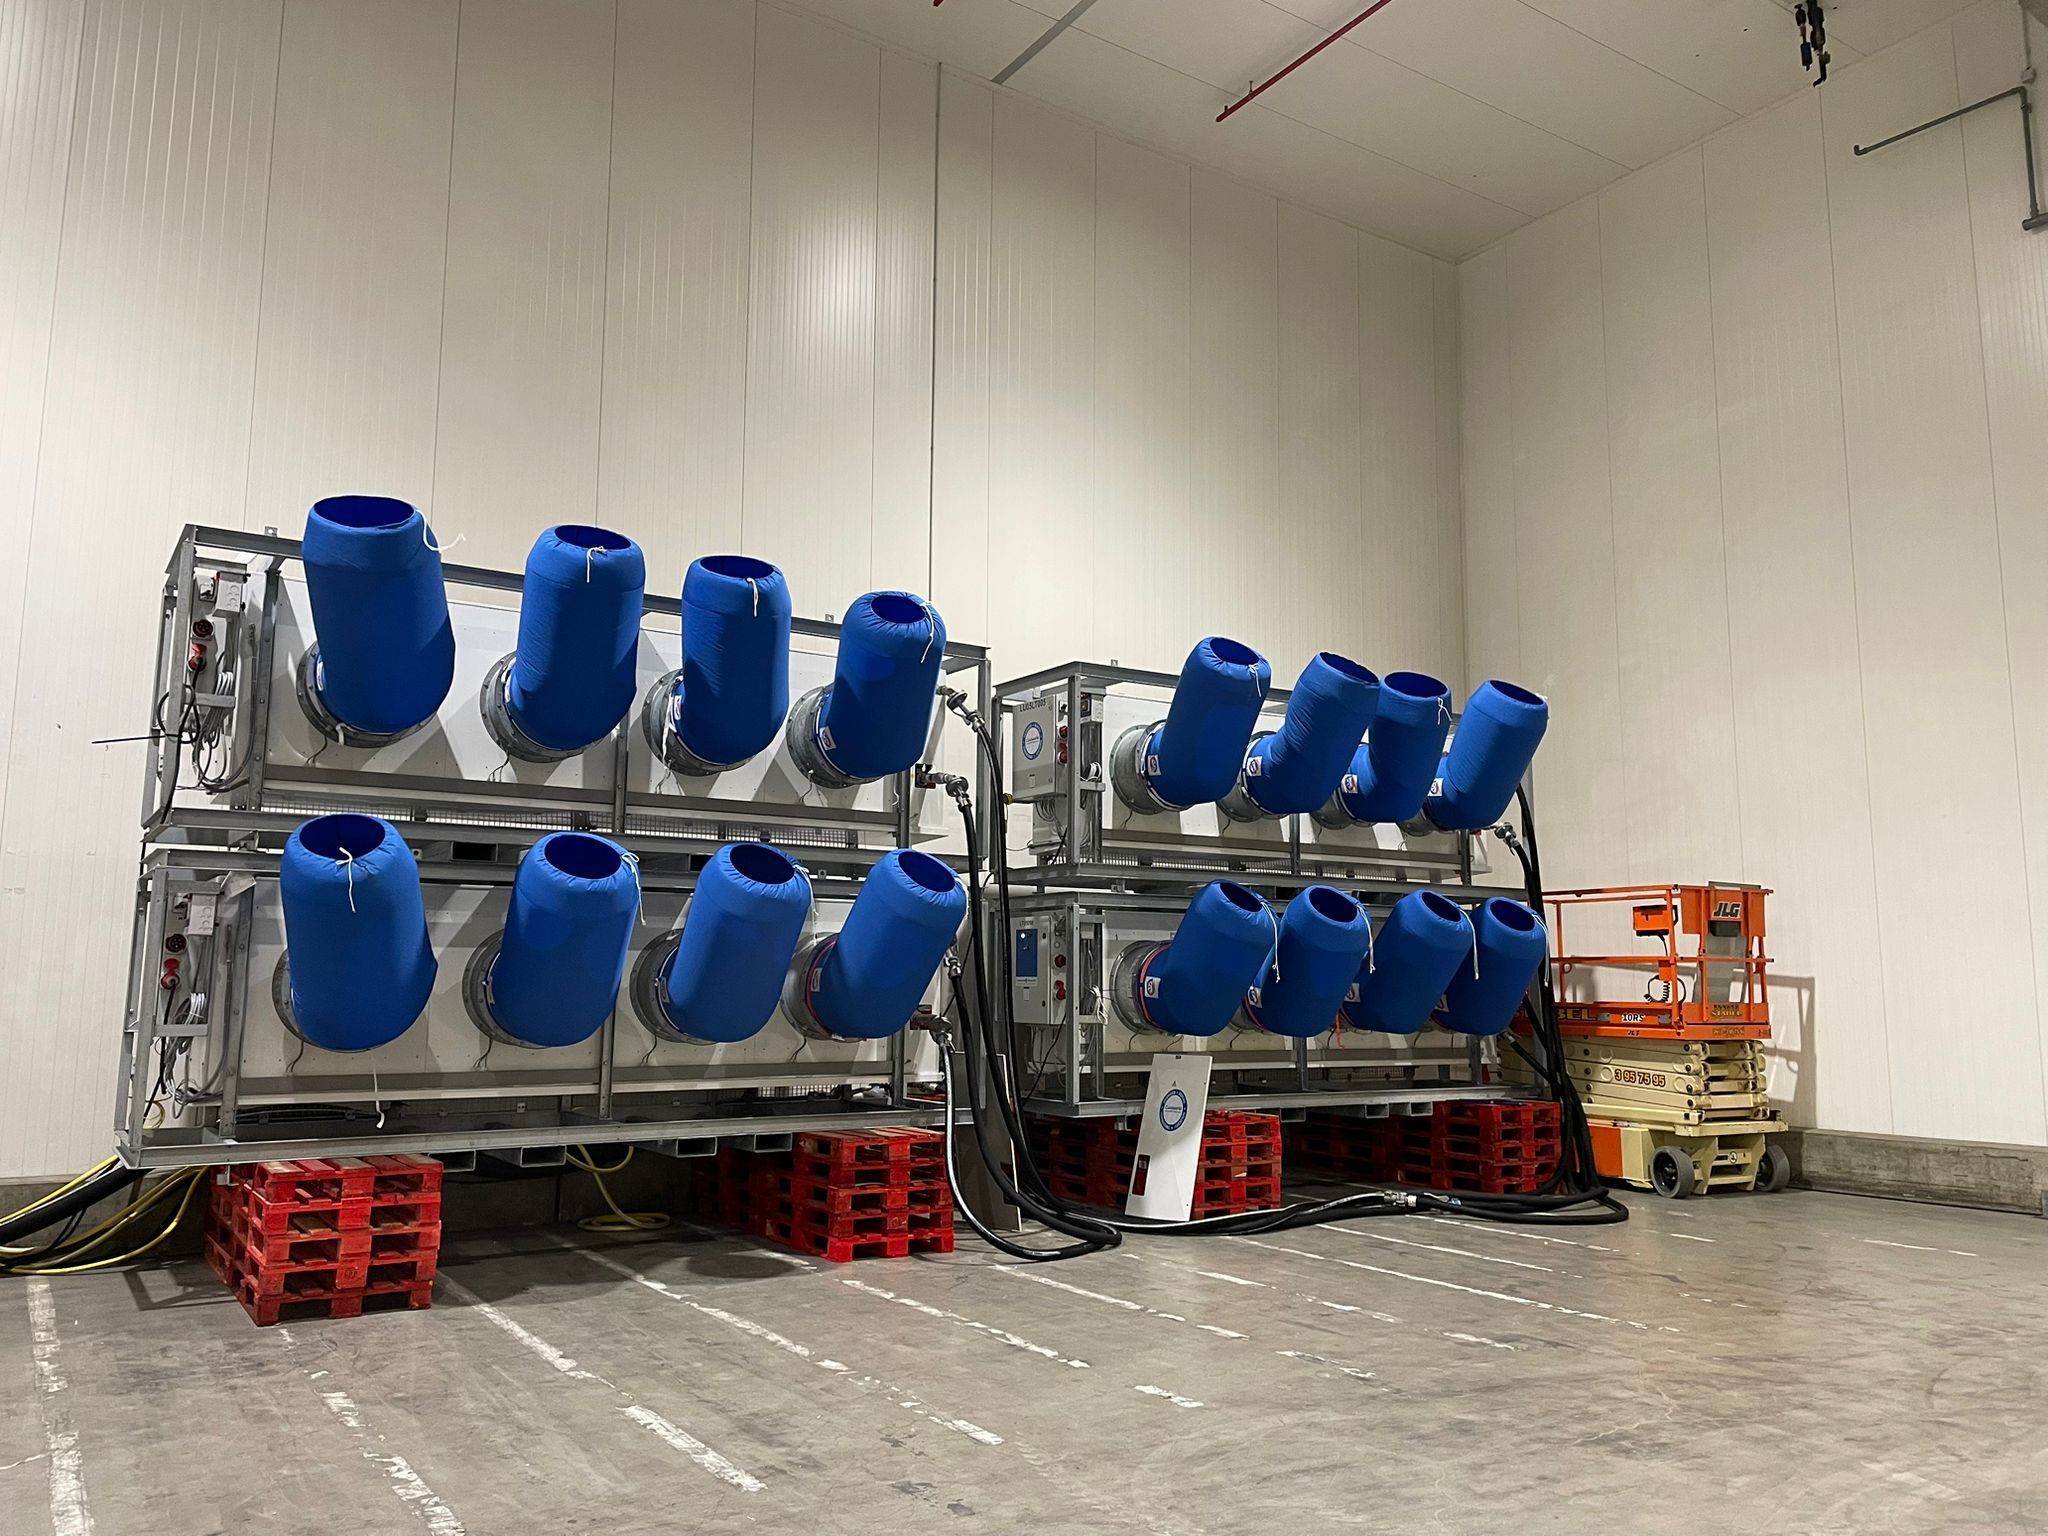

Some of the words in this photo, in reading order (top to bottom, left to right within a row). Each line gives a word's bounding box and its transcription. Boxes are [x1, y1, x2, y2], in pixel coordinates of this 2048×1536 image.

[1713, 902, 1741, 917] JLG
[1614, 1069, 1622, 1081] 3
[1623, 1070, 1637, 1083] 95
[1637, 1071, 1651, 1085] 75
[1652, 1074, 1666, 1087] 95
